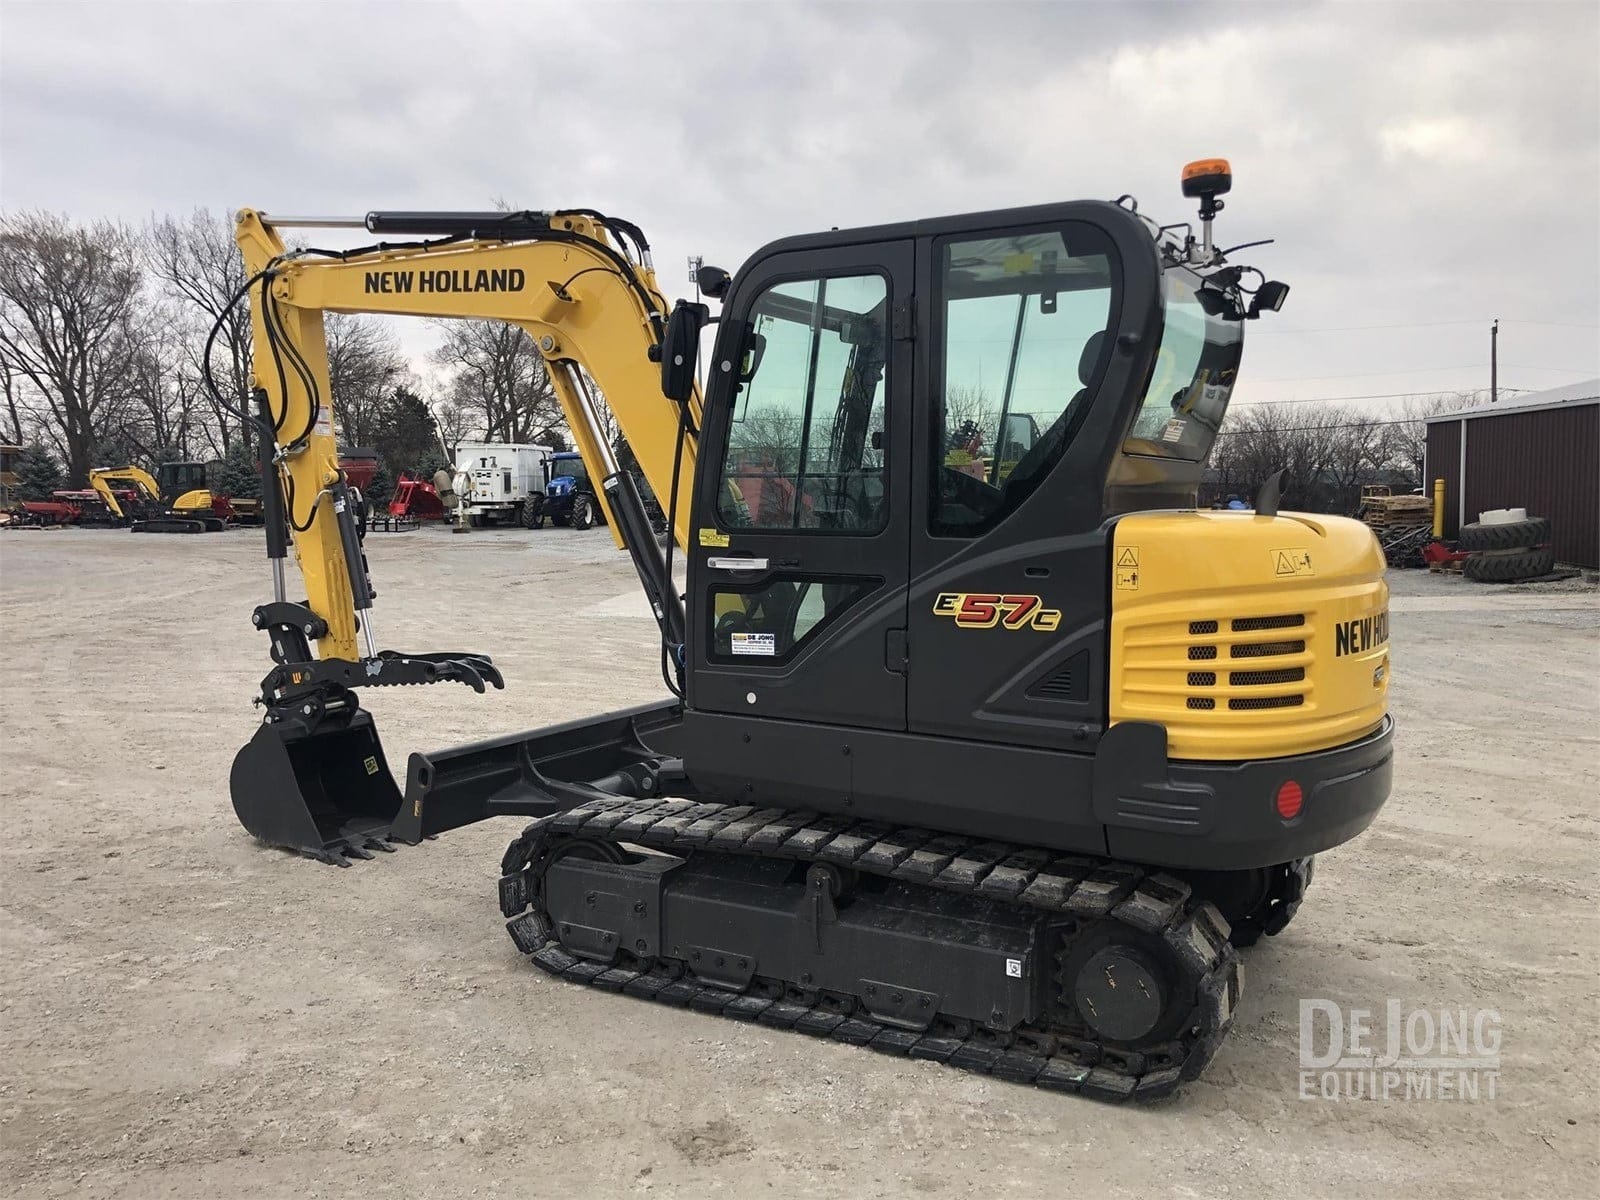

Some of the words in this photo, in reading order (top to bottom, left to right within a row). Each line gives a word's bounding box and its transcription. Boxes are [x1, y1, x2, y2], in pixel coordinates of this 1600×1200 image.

[365, 271, 414, 294] NEW
[419, 269, 526, 293] HOLLAND
[1335, 617, 1372, 657] NEW
